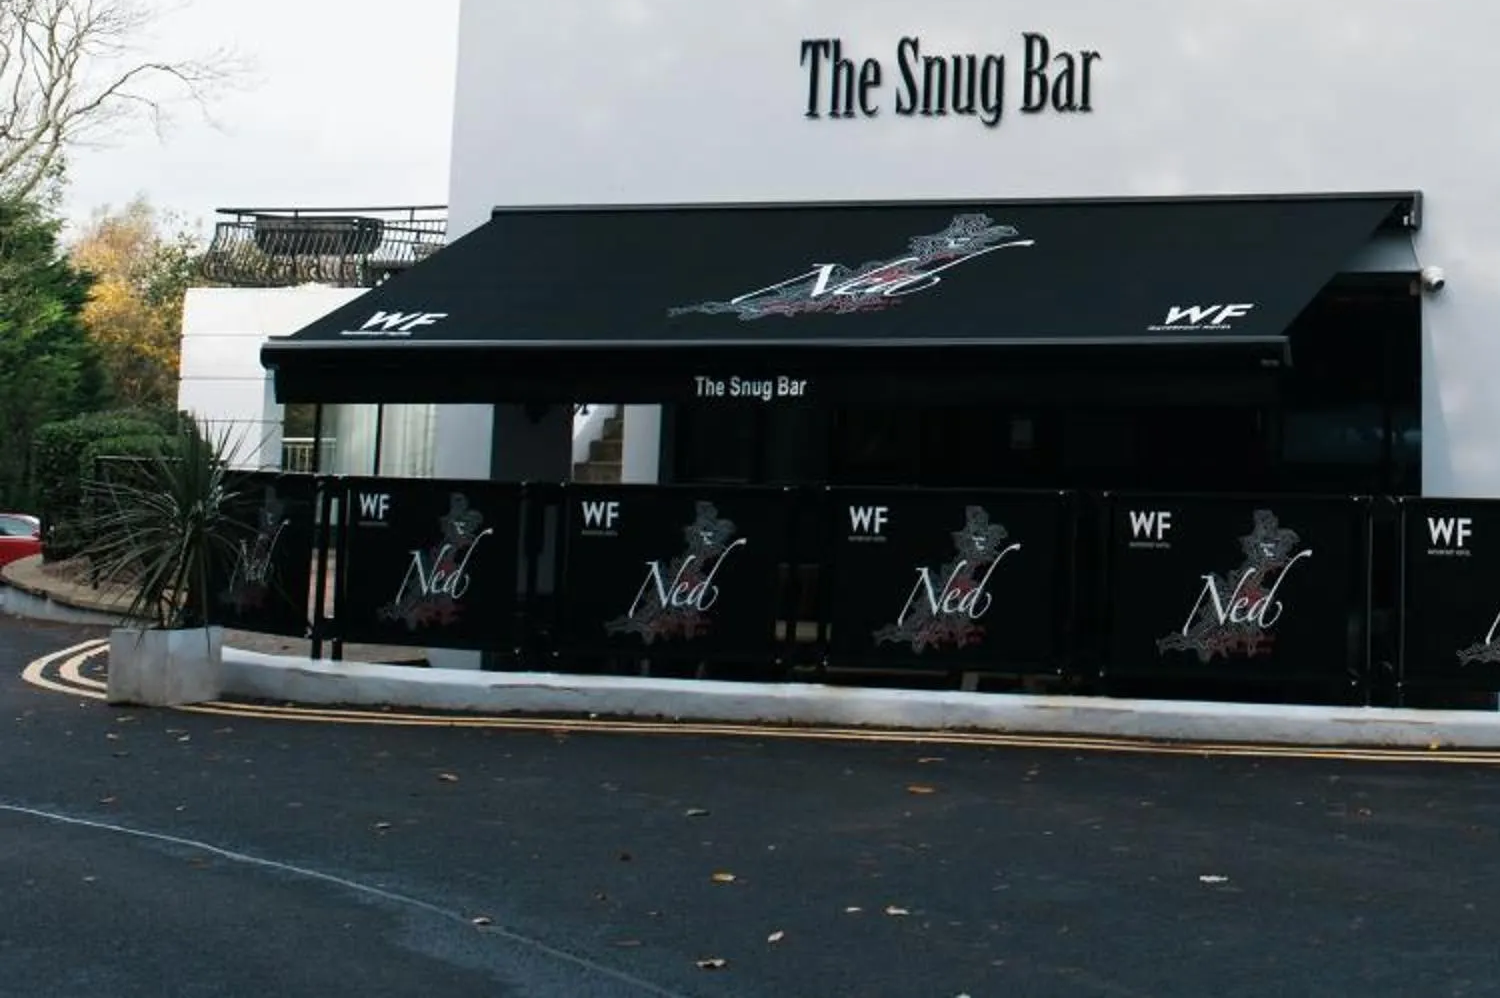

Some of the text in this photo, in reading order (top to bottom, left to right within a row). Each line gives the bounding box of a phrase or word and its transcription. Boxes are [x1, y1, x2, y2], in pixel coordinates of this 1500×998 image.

[800, 31, 1102, 128] The Snug Bar
[731, 238, 1034, 304] Ned
[359, 310, 449, 331] WF
[1165, 303, 1255, 325] WF
[694, 375, 807, 401] The Snug Bar
[359, 492, 391, 520] WF
[582, 501, 620, 529] WF
[849, 505, 888, 534] WF
[1129, 510, 1172, 540] WF
[1427, 517, 1473, 547] WF
[395, 527, 494, 605] Ned
[628, 537, 748, 619] Ned
[897, 543, 1021, 627] Ned
[1182, 549, 1313, 637] Ned
